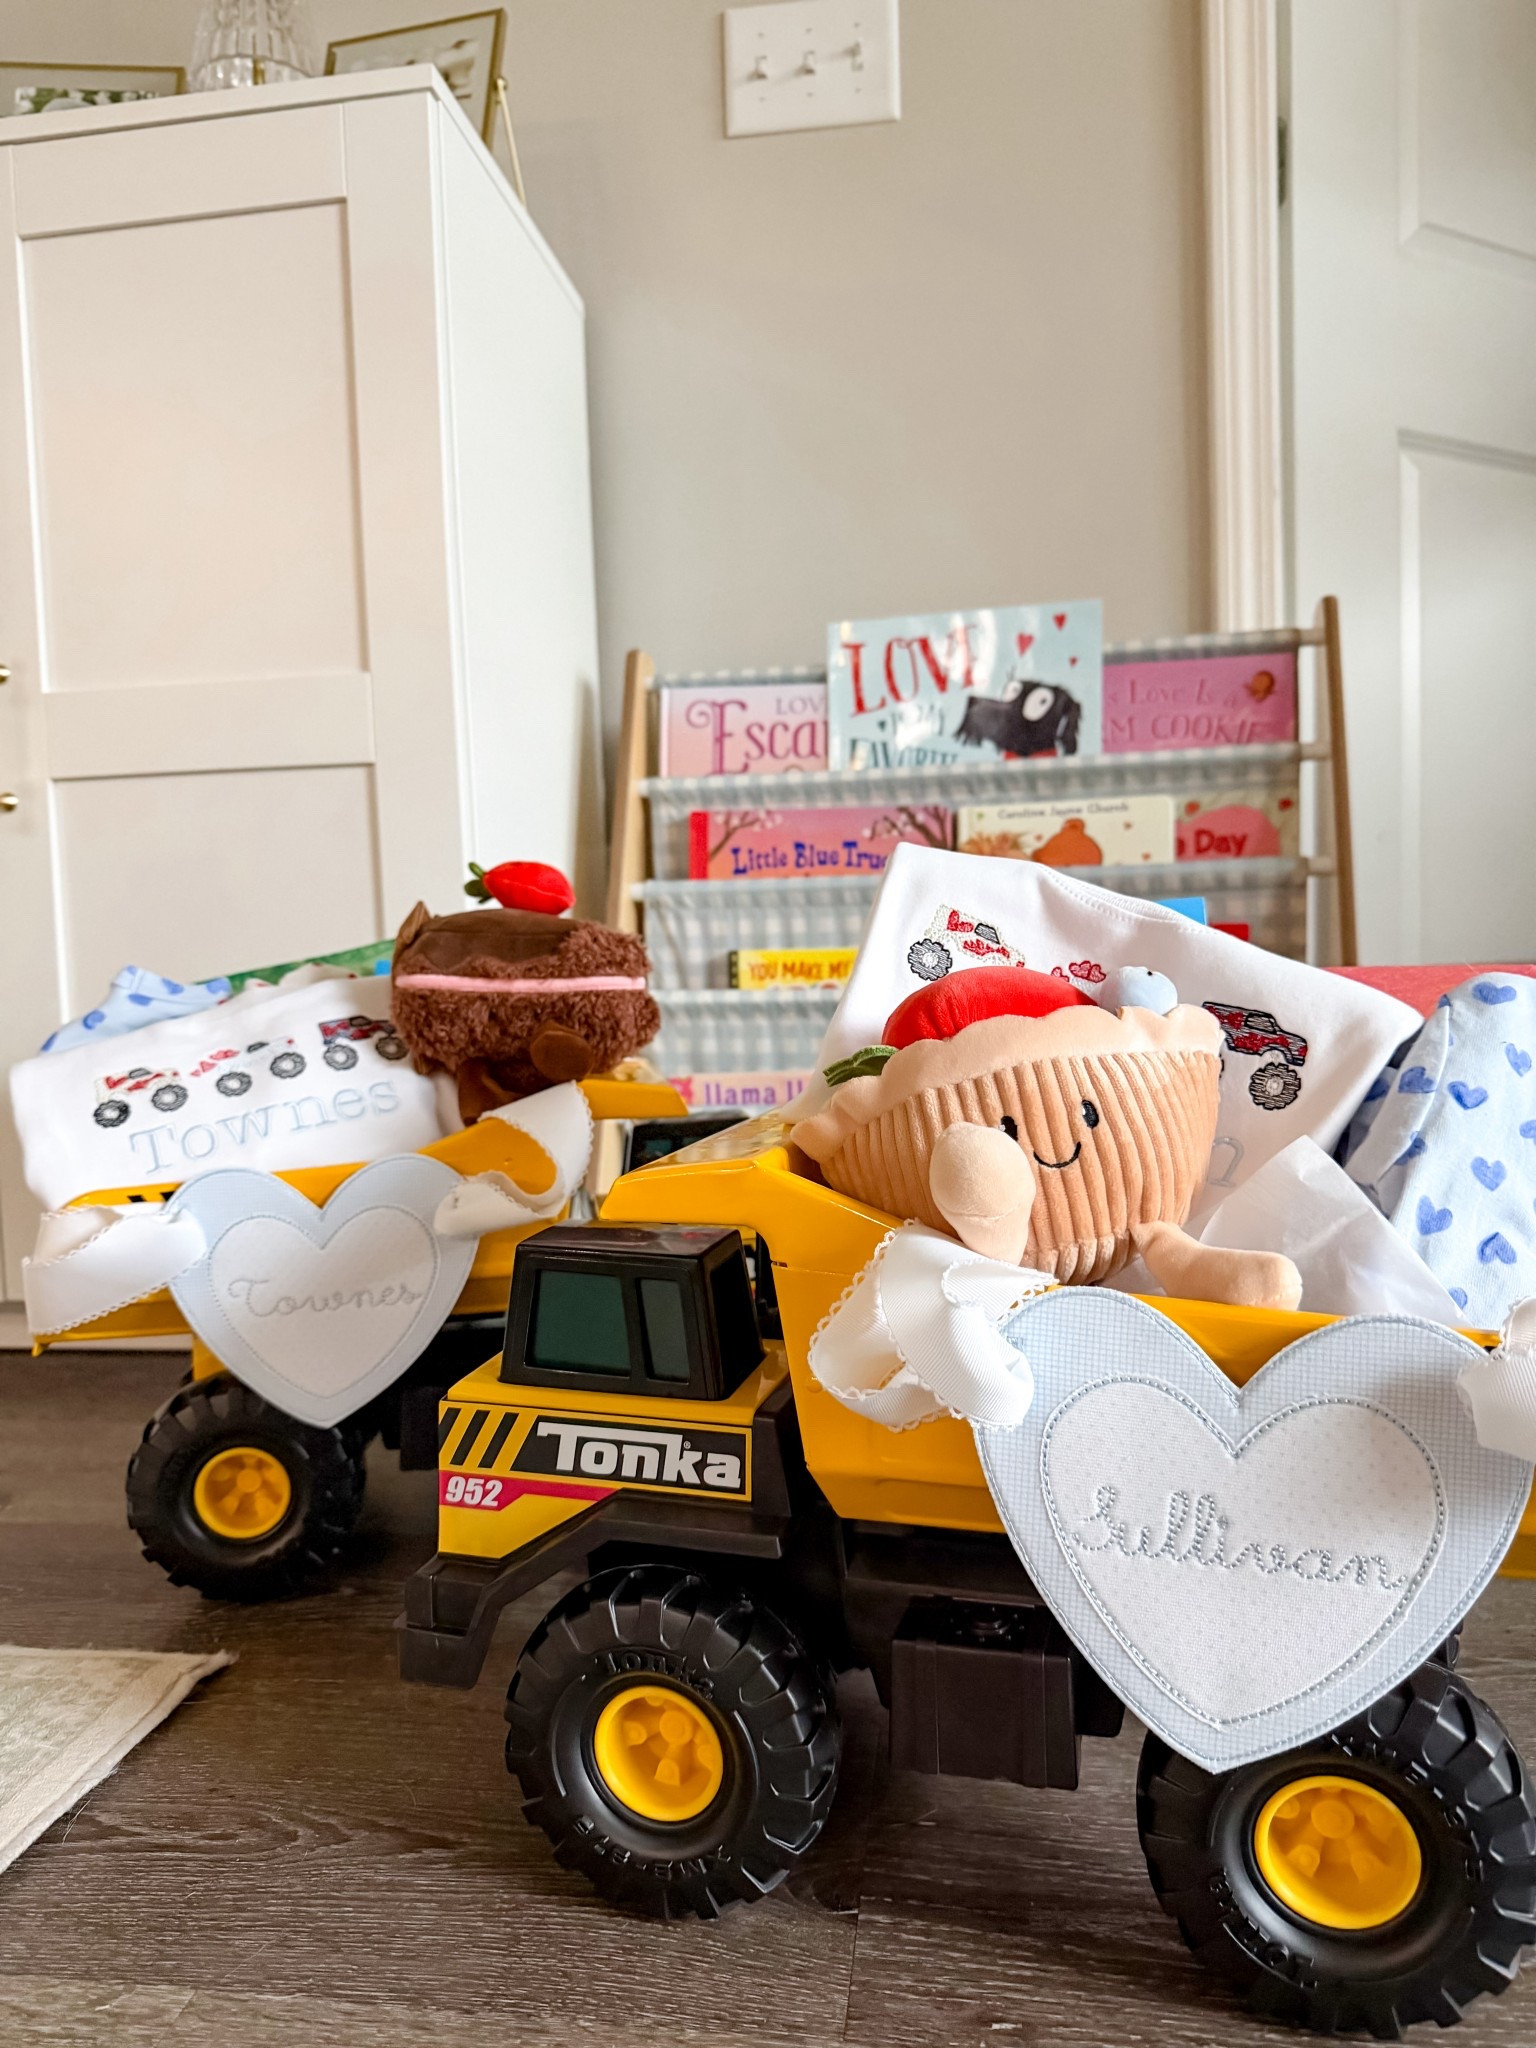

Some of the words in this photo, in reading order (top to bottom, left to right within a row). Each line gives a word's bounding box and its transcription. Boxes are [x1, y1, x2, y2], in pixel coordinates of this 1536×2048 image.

[686, 699, 828, 776] Esca
[730, 847, 788, 876] Little
[793, 842, 839, 869] Blue
[1194, 829, 1248, 856] Day
[705, 1081, 777, 1106] llama
[128, 1079, 402, 1175] Townes
[227, 1278, 422, 1318] Townes
[536, 1420, 742, 1490] Tonka
[445, 1475, 503, 1508] 952
[1071, 1486, 1408, 1590] Sullivan
